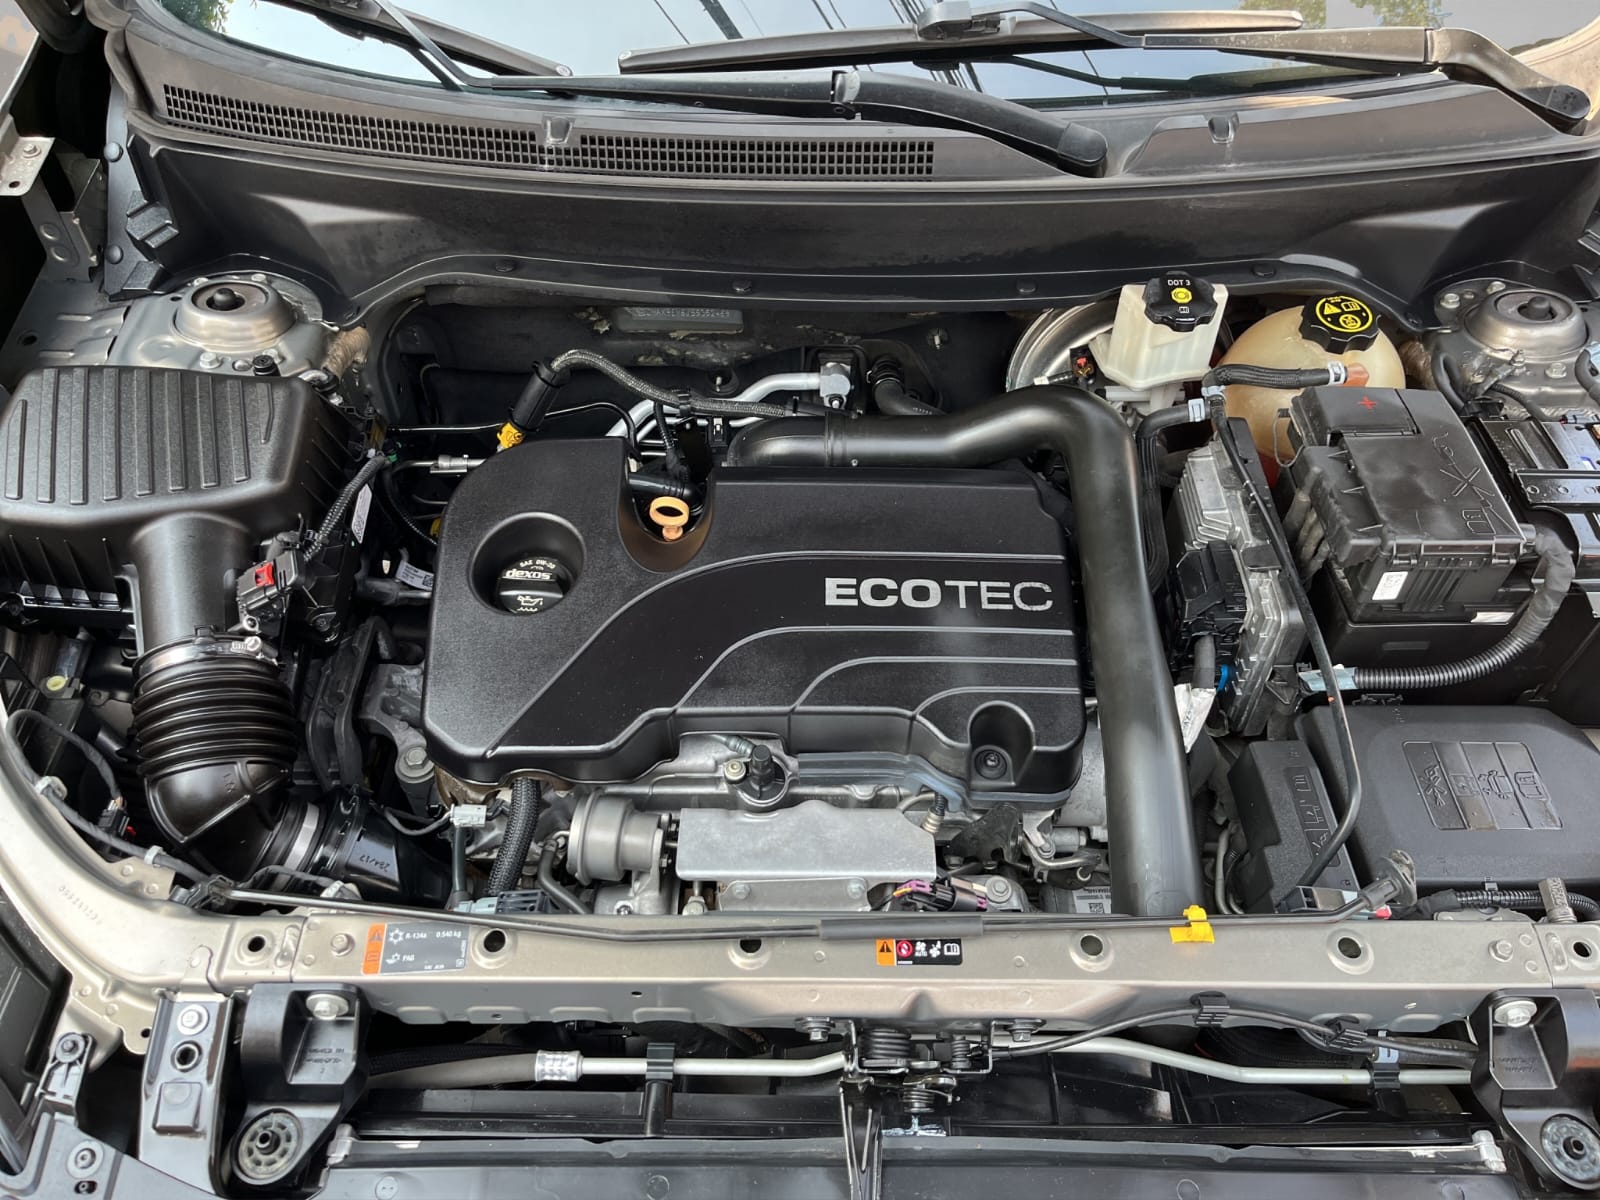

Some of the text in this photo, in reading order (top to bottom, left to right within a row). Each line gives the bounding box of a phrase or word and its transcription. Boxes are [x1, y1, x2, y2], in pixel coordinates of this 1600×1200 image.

[519, 559, 533, 568] SAE
[506, 568, 553, 580] dexos
[824, 577, 1053, 611] ECOTEC
